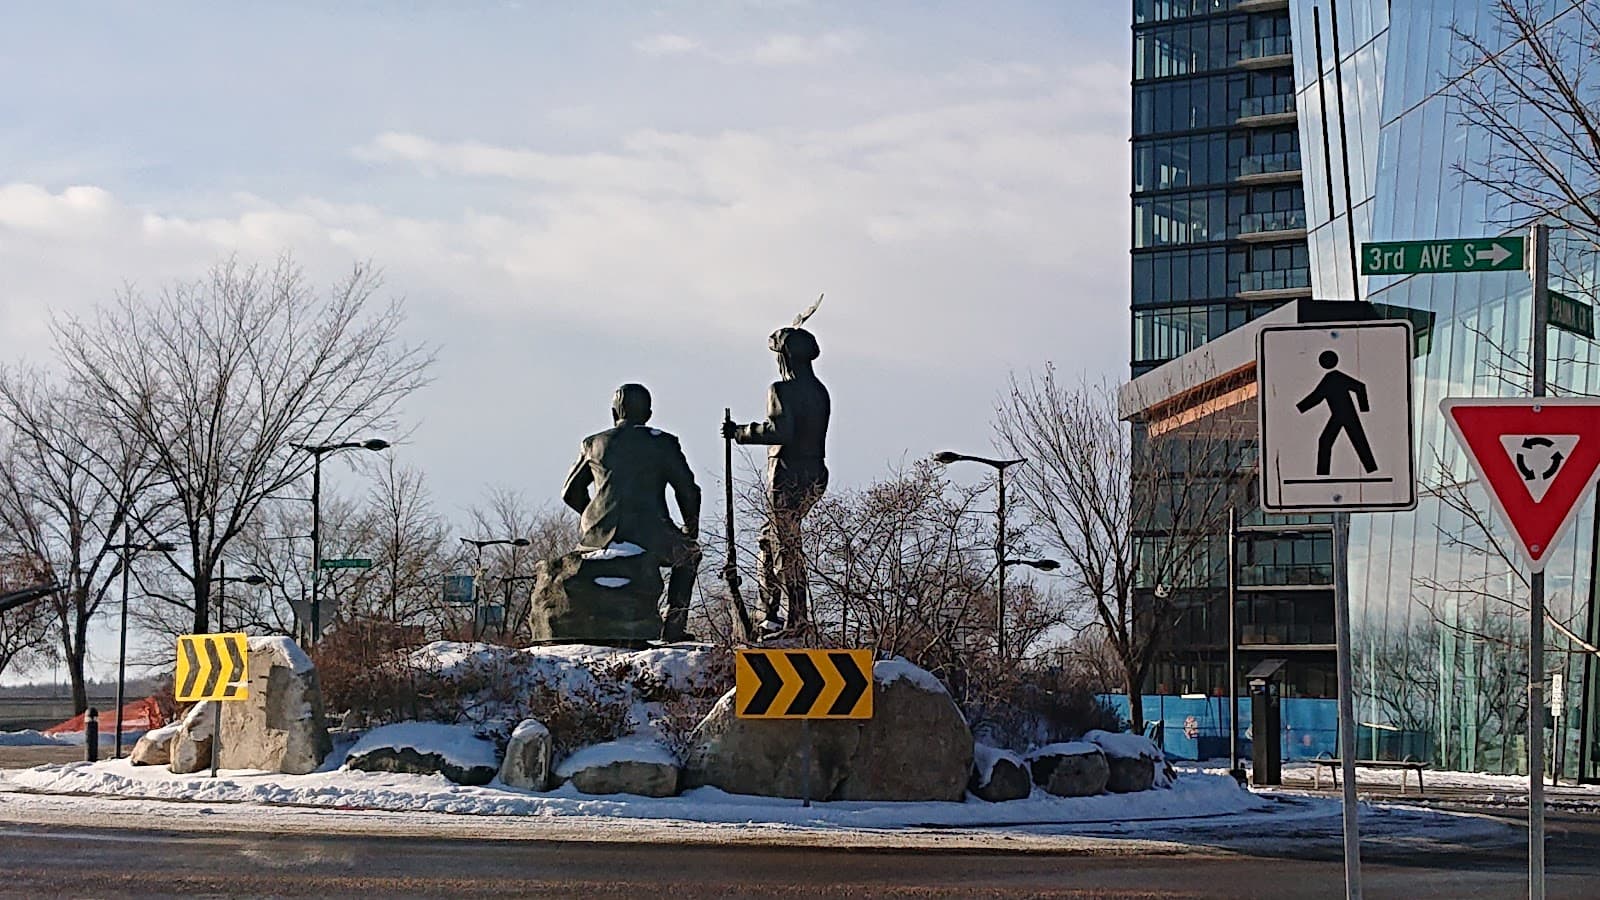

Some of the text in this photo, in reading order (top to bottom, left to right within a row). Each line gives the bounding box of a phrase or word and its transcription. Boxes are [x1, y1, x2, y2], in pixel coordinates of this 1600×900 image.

[1368, 243, 1475, 271] 3rd AVE S
